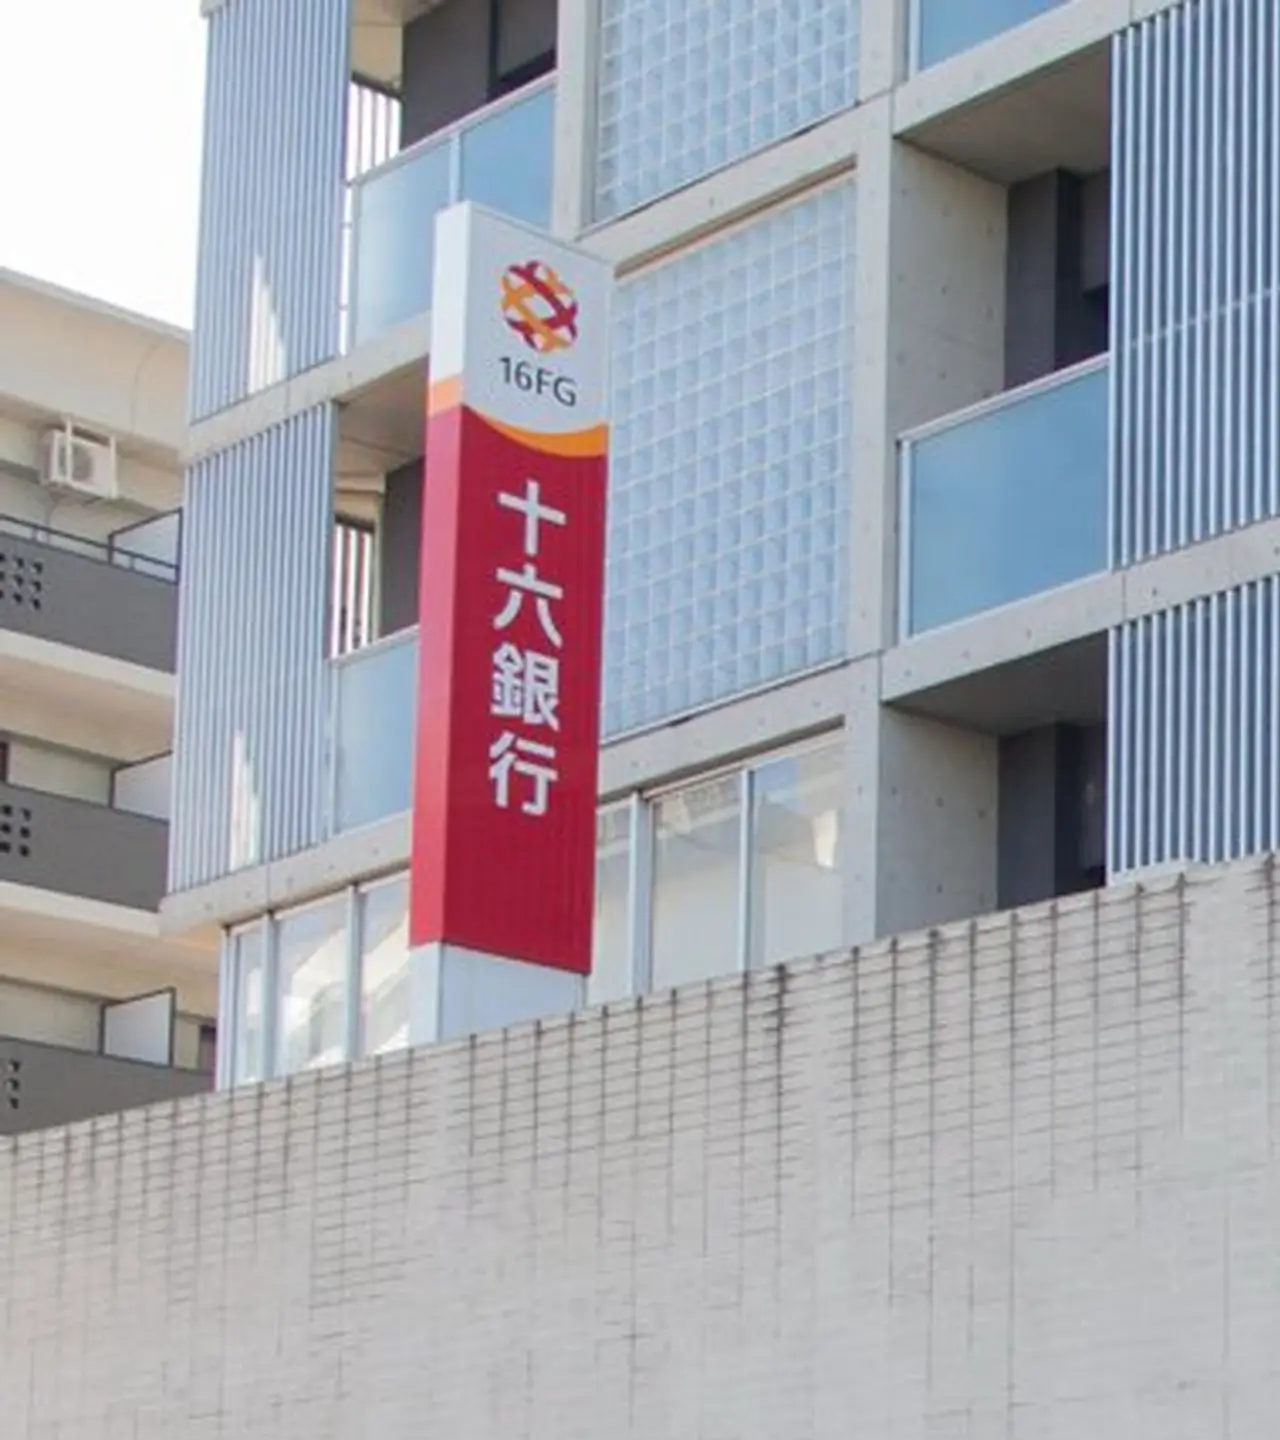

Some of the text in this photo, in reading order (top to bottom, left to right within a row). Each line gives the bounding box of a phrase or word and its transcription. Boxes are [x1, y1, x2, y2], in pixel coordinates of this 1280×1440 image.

[499, 357, 577, 407] 16FG
[489, 478, 567, 816] 十六銀行
